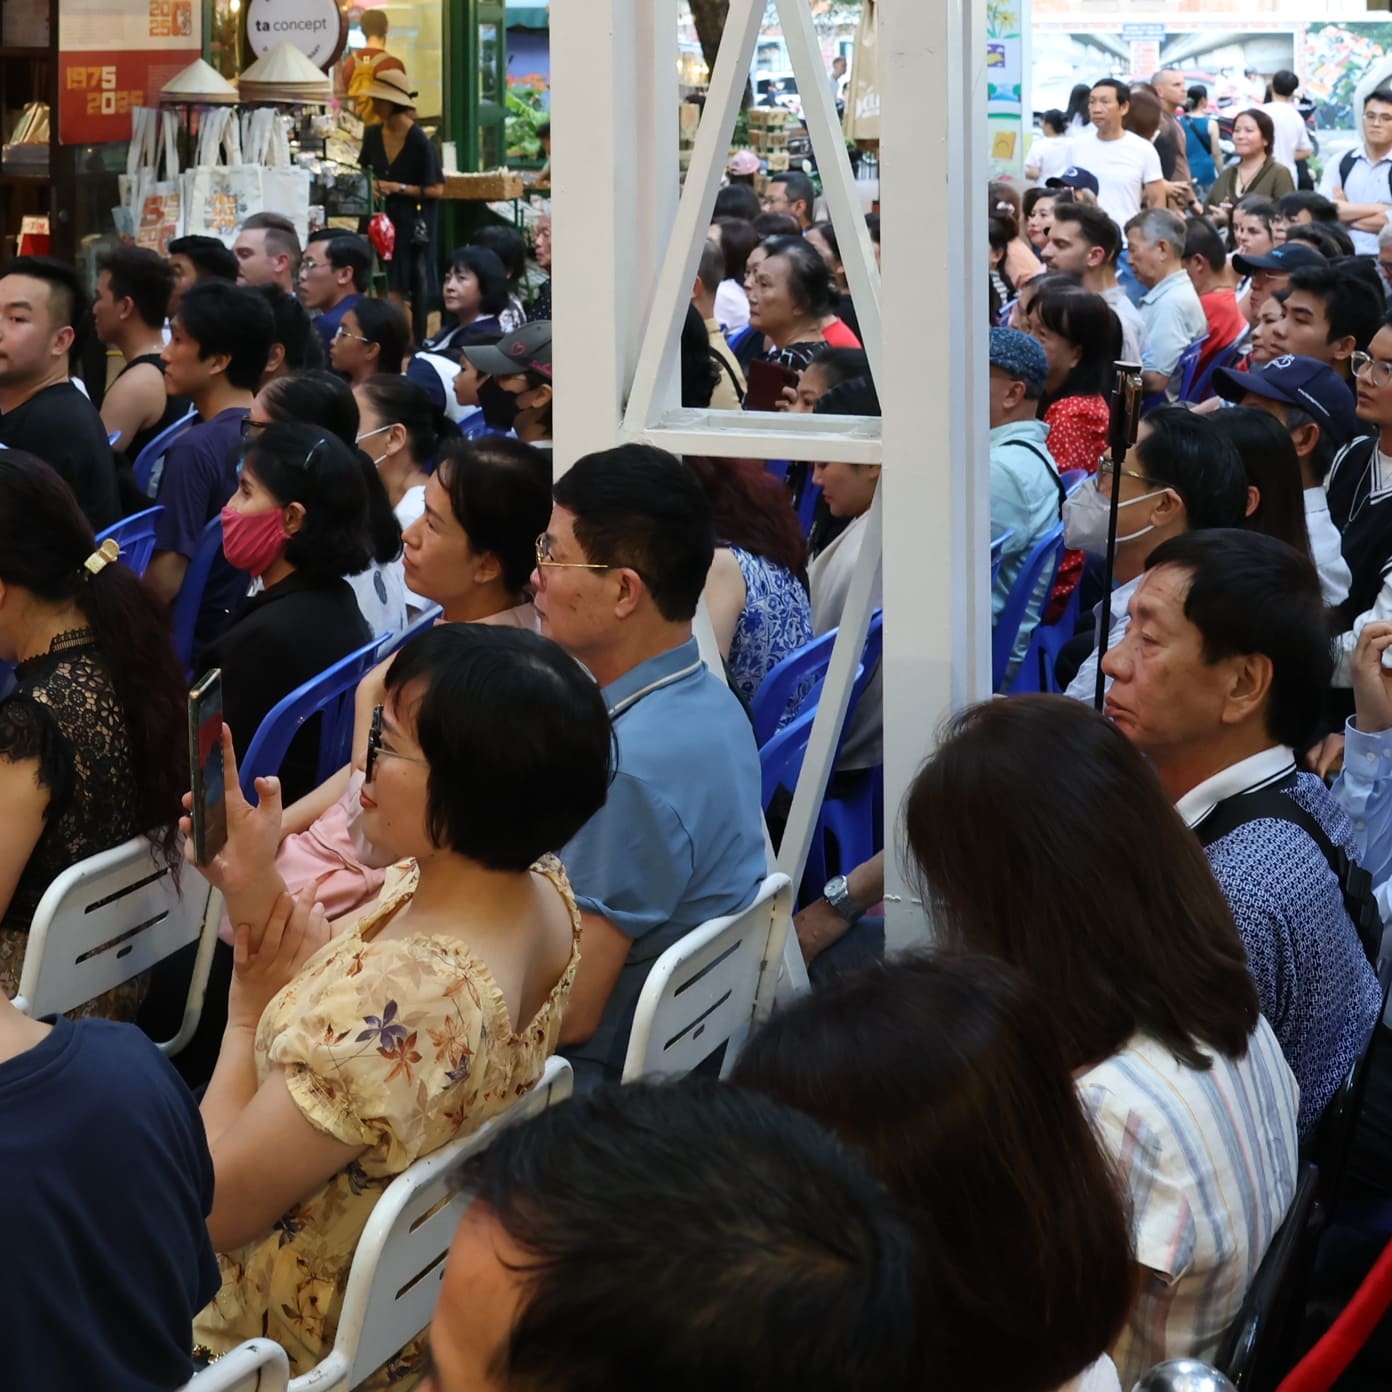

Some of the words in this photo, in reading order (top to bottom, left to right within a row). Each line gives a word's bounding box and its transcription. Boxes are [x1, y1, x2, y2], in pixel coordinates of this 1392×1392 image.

[255, 19, 270, 32] ta
[272, 18, 327, 33] concept
[65, 65, 116, 90] 1975
